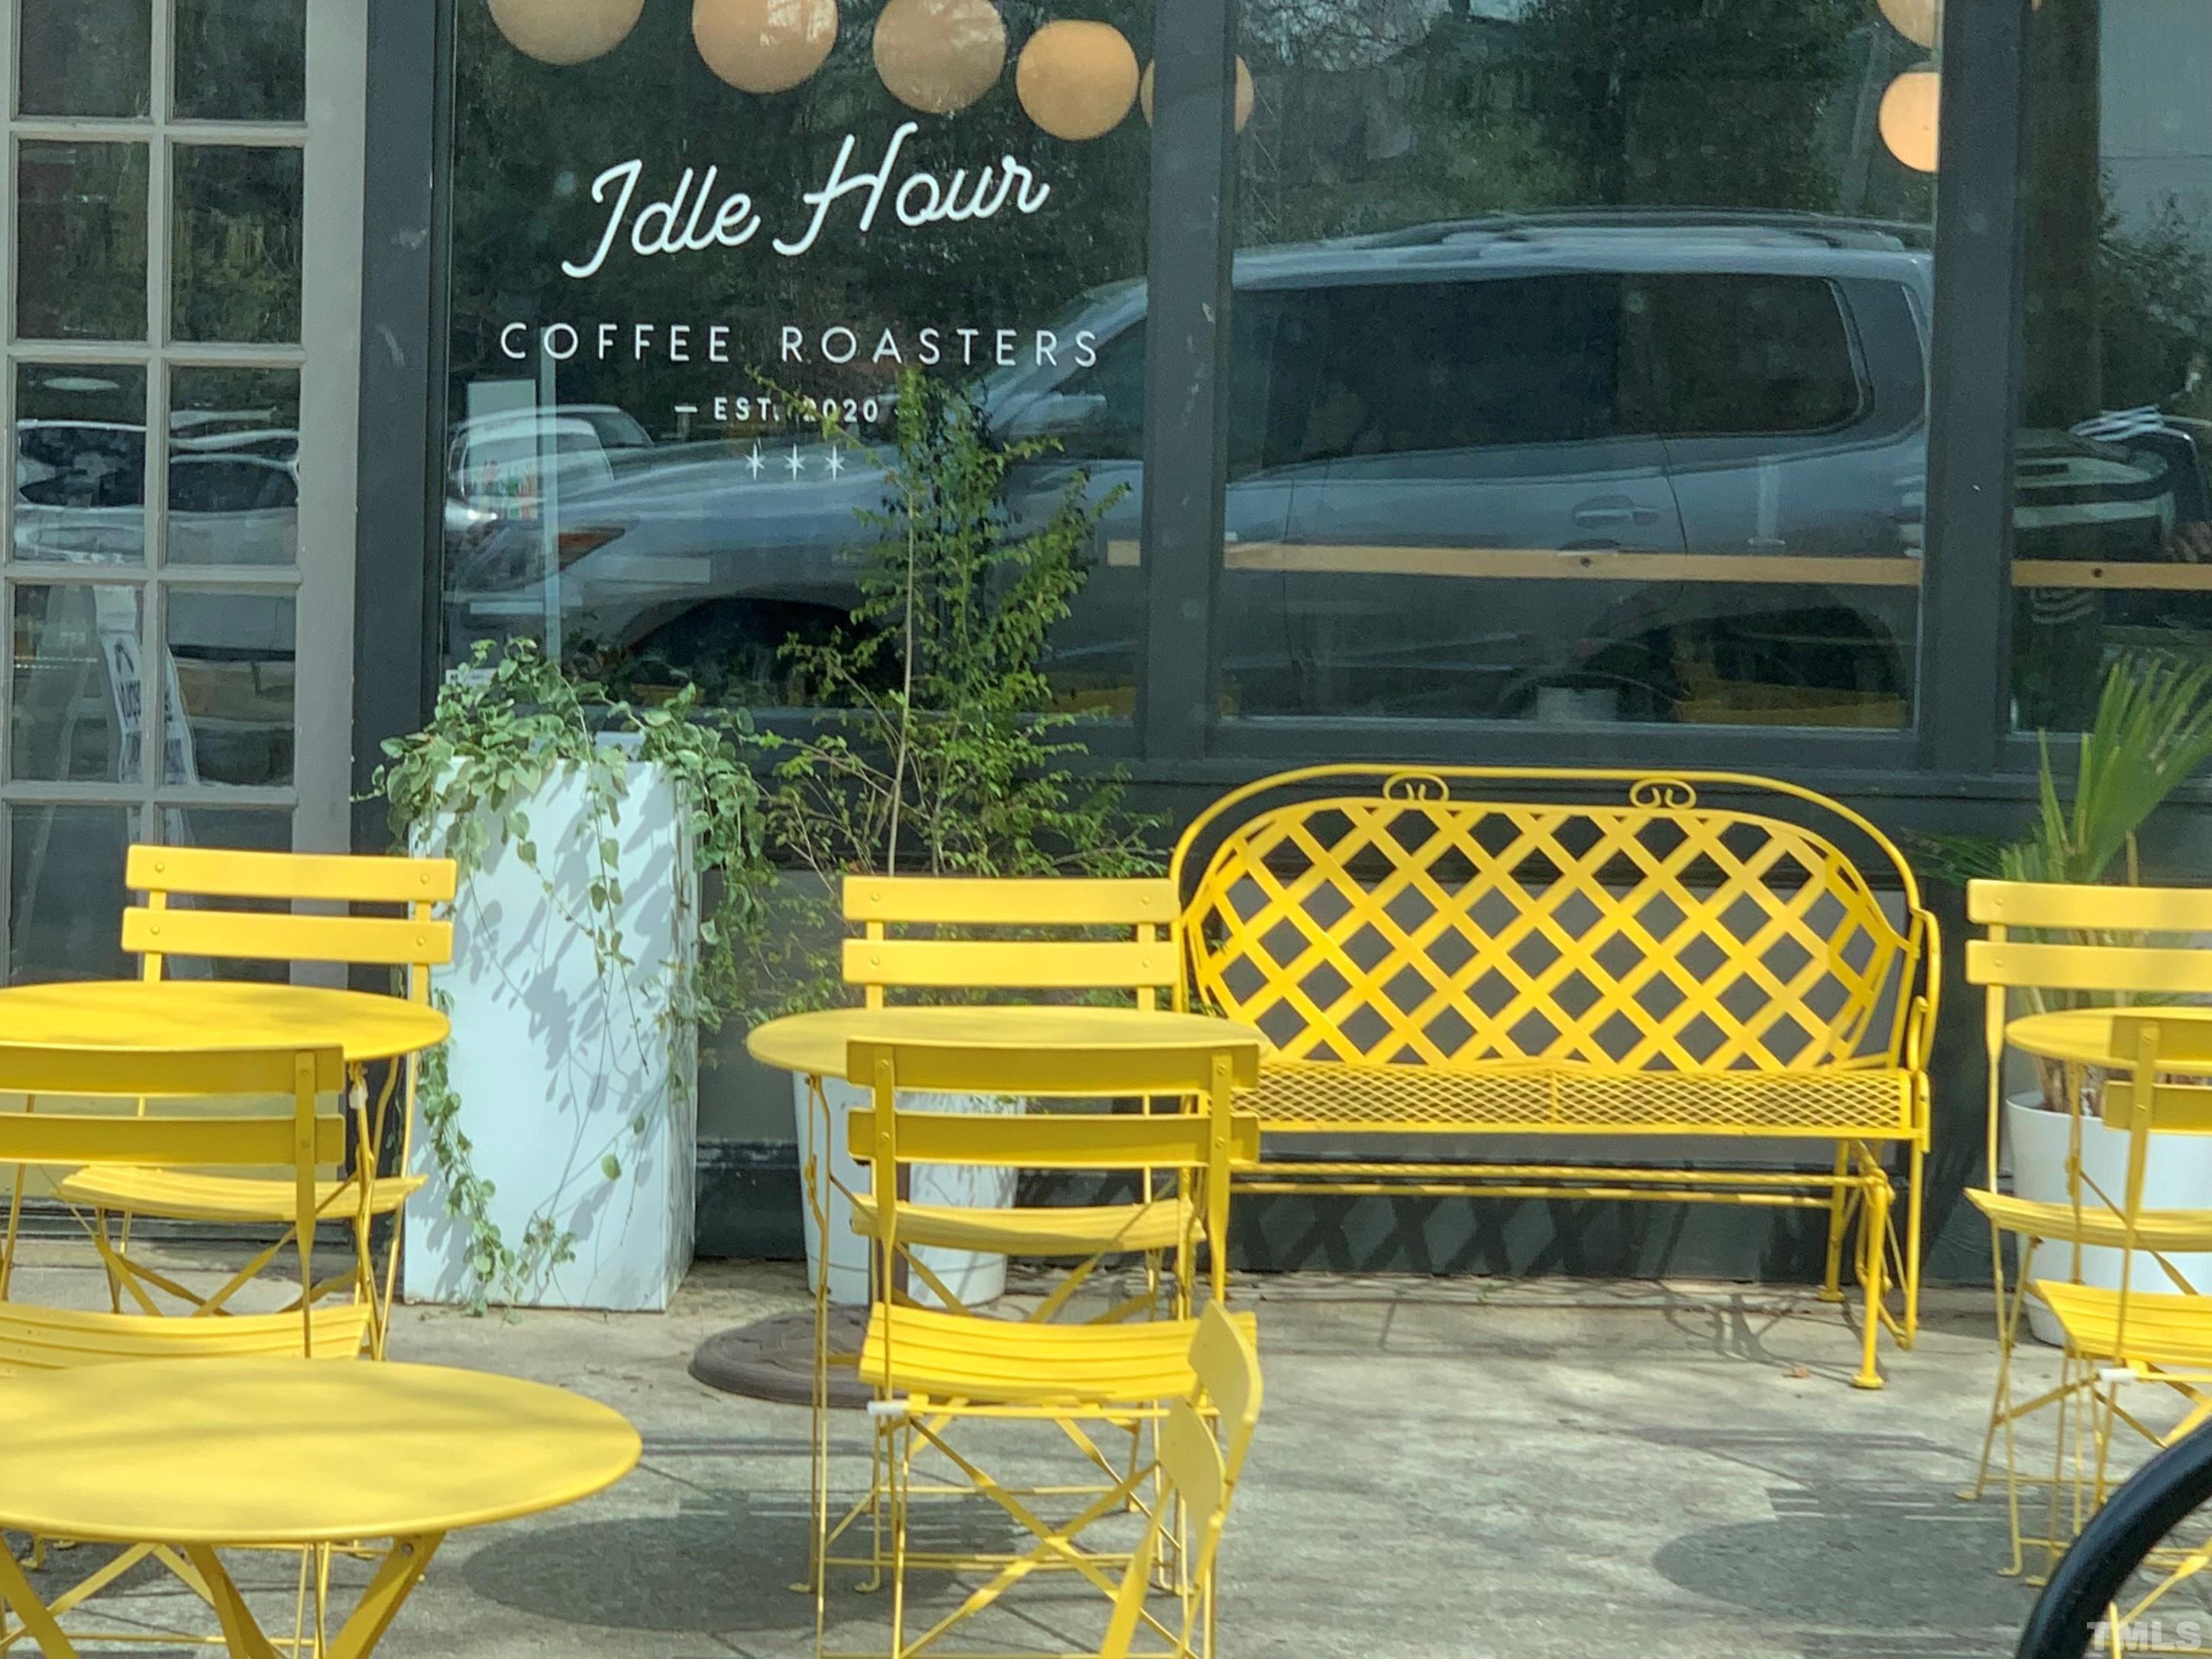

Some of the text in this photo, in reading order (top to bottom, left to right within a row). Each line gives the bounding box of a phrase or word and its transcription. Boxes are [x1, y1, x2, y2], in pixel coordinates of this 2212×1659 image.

[561, 121, 1051, 279] Idle Hour
[500, 322, 1098, 367] COFFEE ROASTERS
